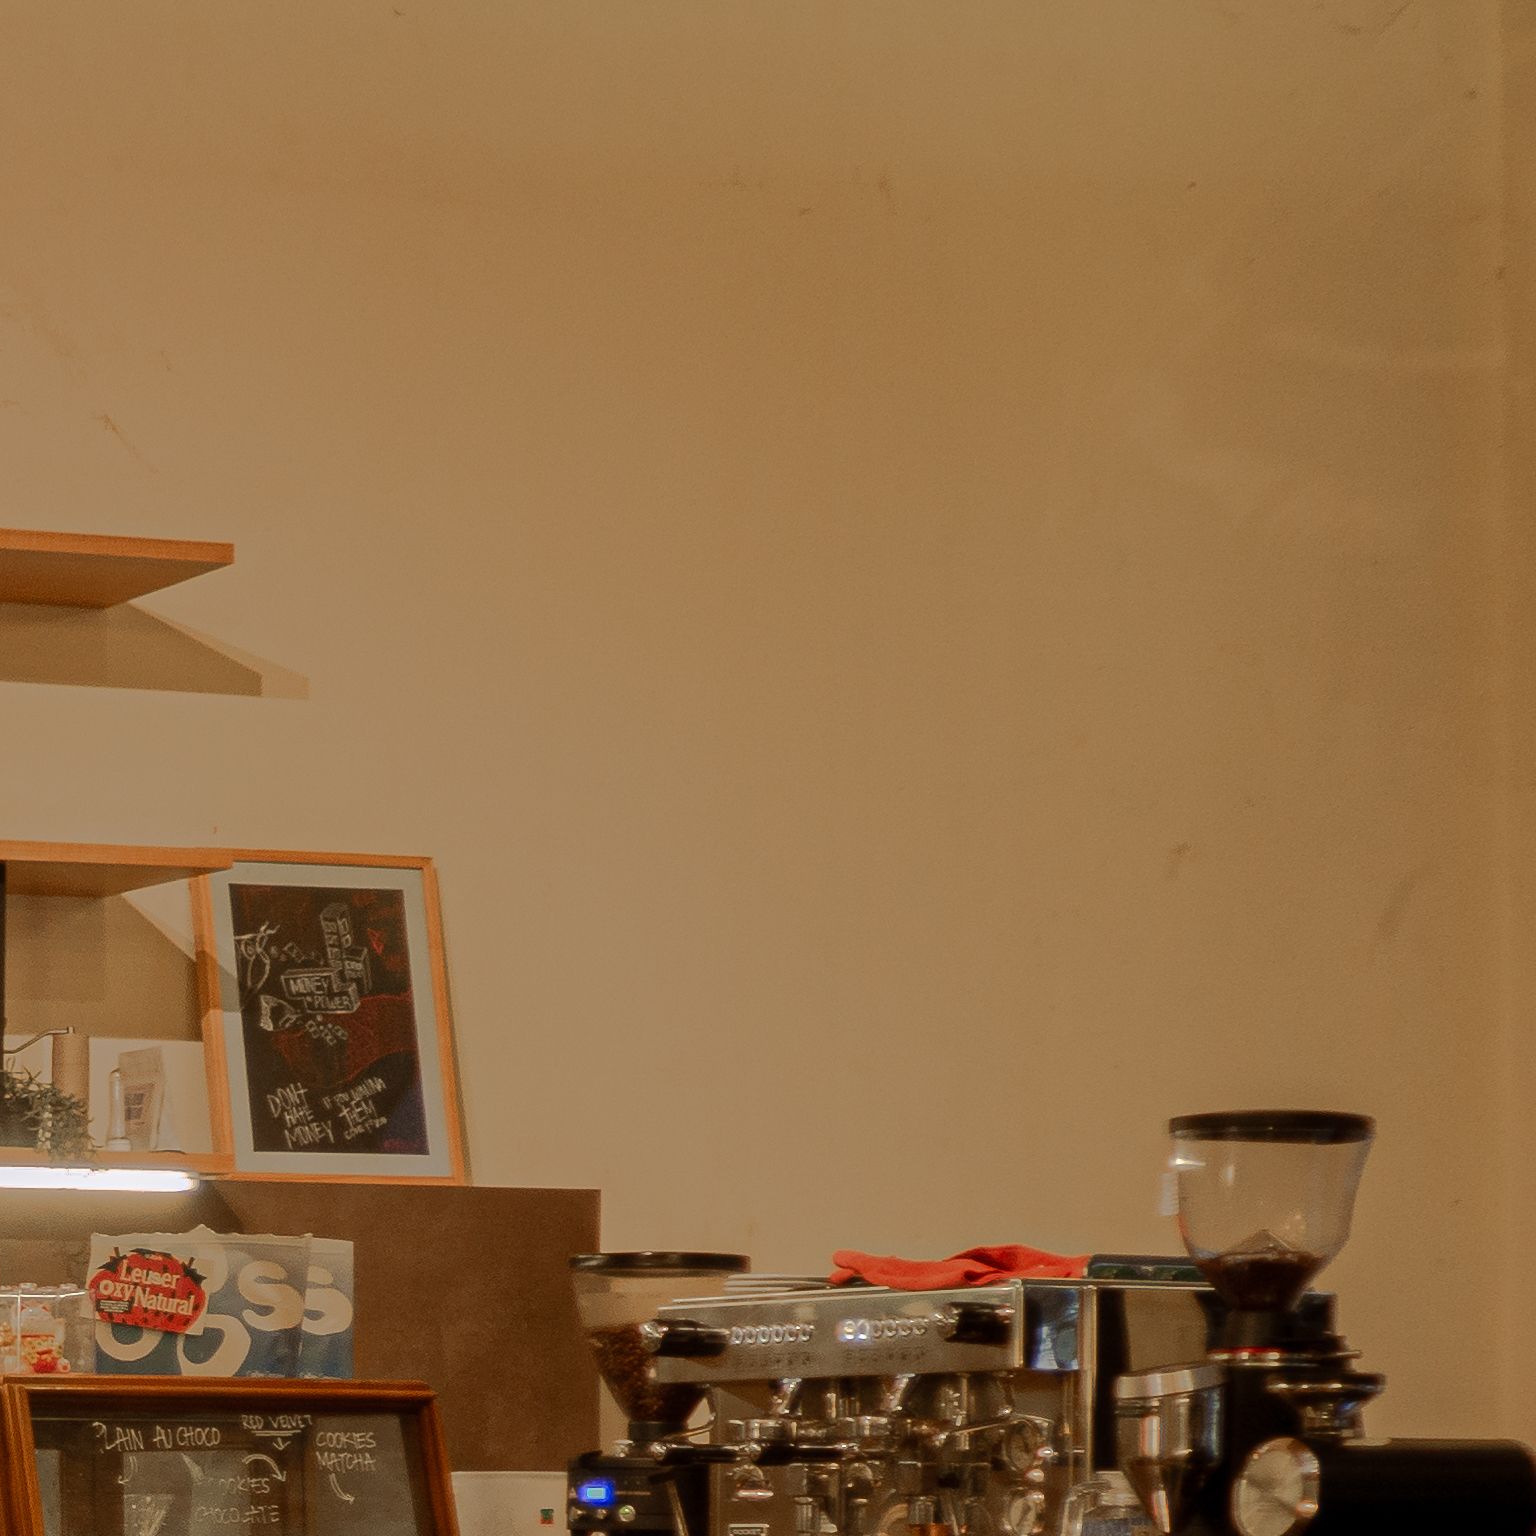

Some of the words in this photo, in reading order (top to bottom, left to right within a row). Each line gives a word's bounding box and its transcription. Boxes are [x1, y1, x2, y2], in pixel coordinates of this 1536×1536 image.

[119, 1259, 181, 1289] Leuser
[315, 1431, 376, 1450] COOKIES
[315, 1451, 377, 1473] MATCHA
